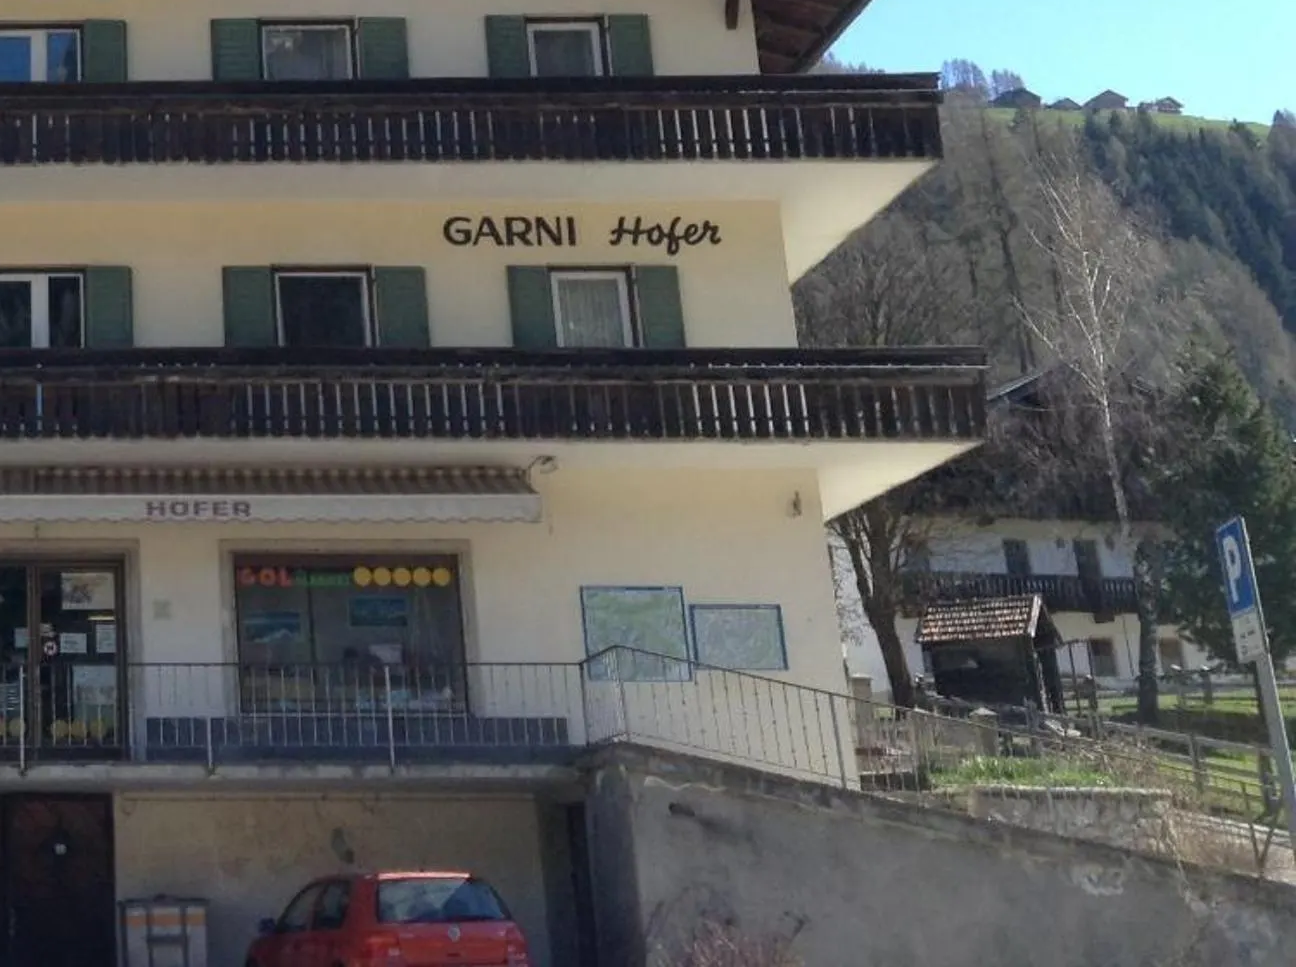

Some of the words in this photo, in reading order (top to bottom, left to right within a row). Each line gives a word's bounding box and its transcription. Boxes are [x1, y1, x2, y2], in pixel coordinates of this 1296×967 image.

[442, 215, 577, 247] GARNI
[608, 215, 722, 256] Hofer
[145, 500, 252, 518] HOFER
[1222, 534, 1242, 604] P
